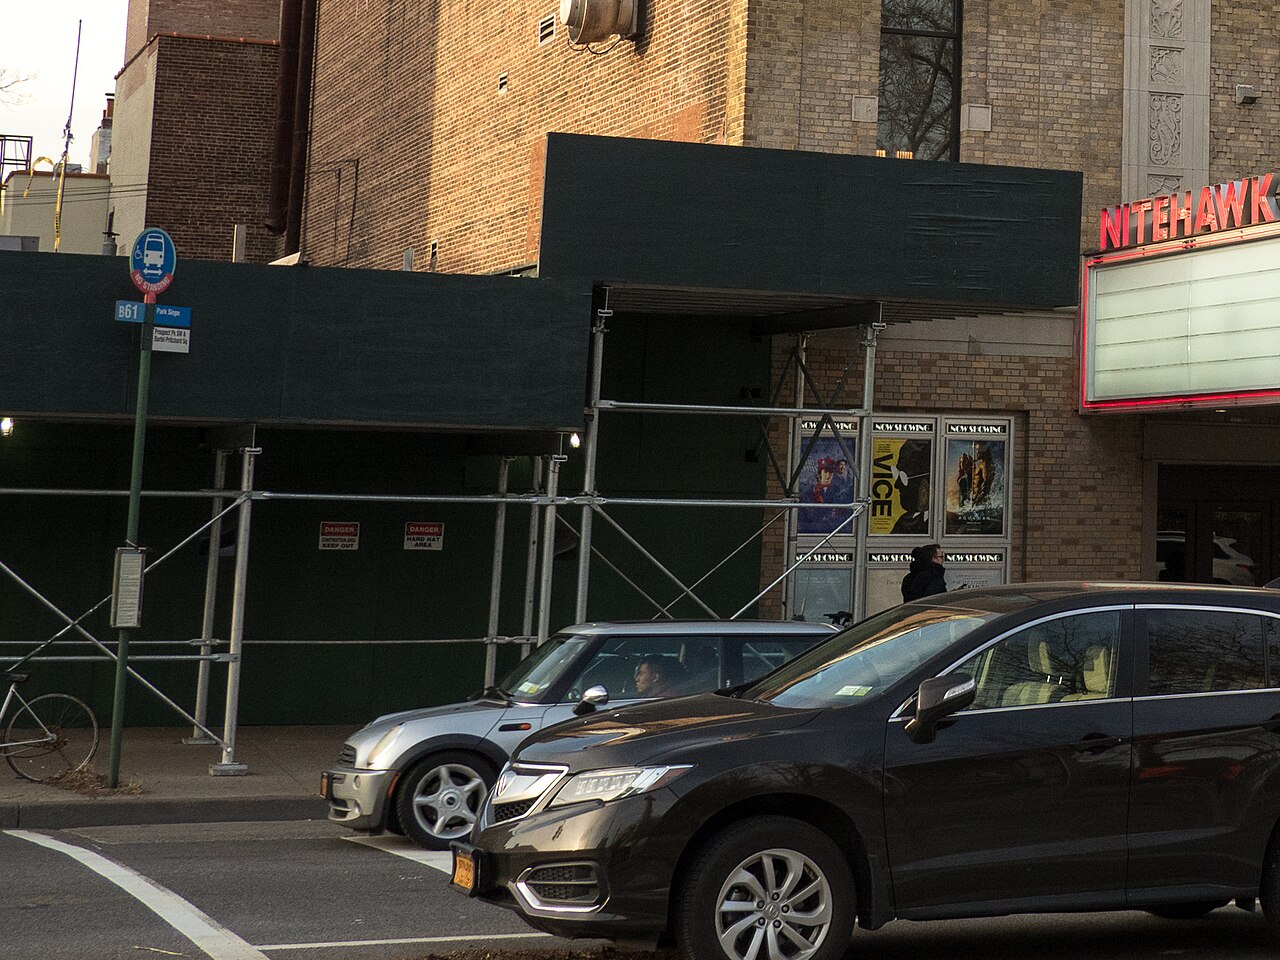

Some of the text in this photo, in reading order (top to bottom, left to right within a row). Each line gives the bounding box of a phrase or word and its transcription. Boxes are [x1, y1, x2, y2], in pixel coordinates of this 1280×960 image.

[1100, 174, 1280, 249] NITEHAWK
[143, 276, 170, 291] STANDING
[118, 303, 139, 320] B61
[875, 423, 930, 432] NOW SHOWING
[950, 425, 1004, 433] NOW SHOWING
[872, 453, 894, 517] VICE
[871, 554, 889, 562] NOW
[946, 554, 1001, 563] NOW SHOWING
